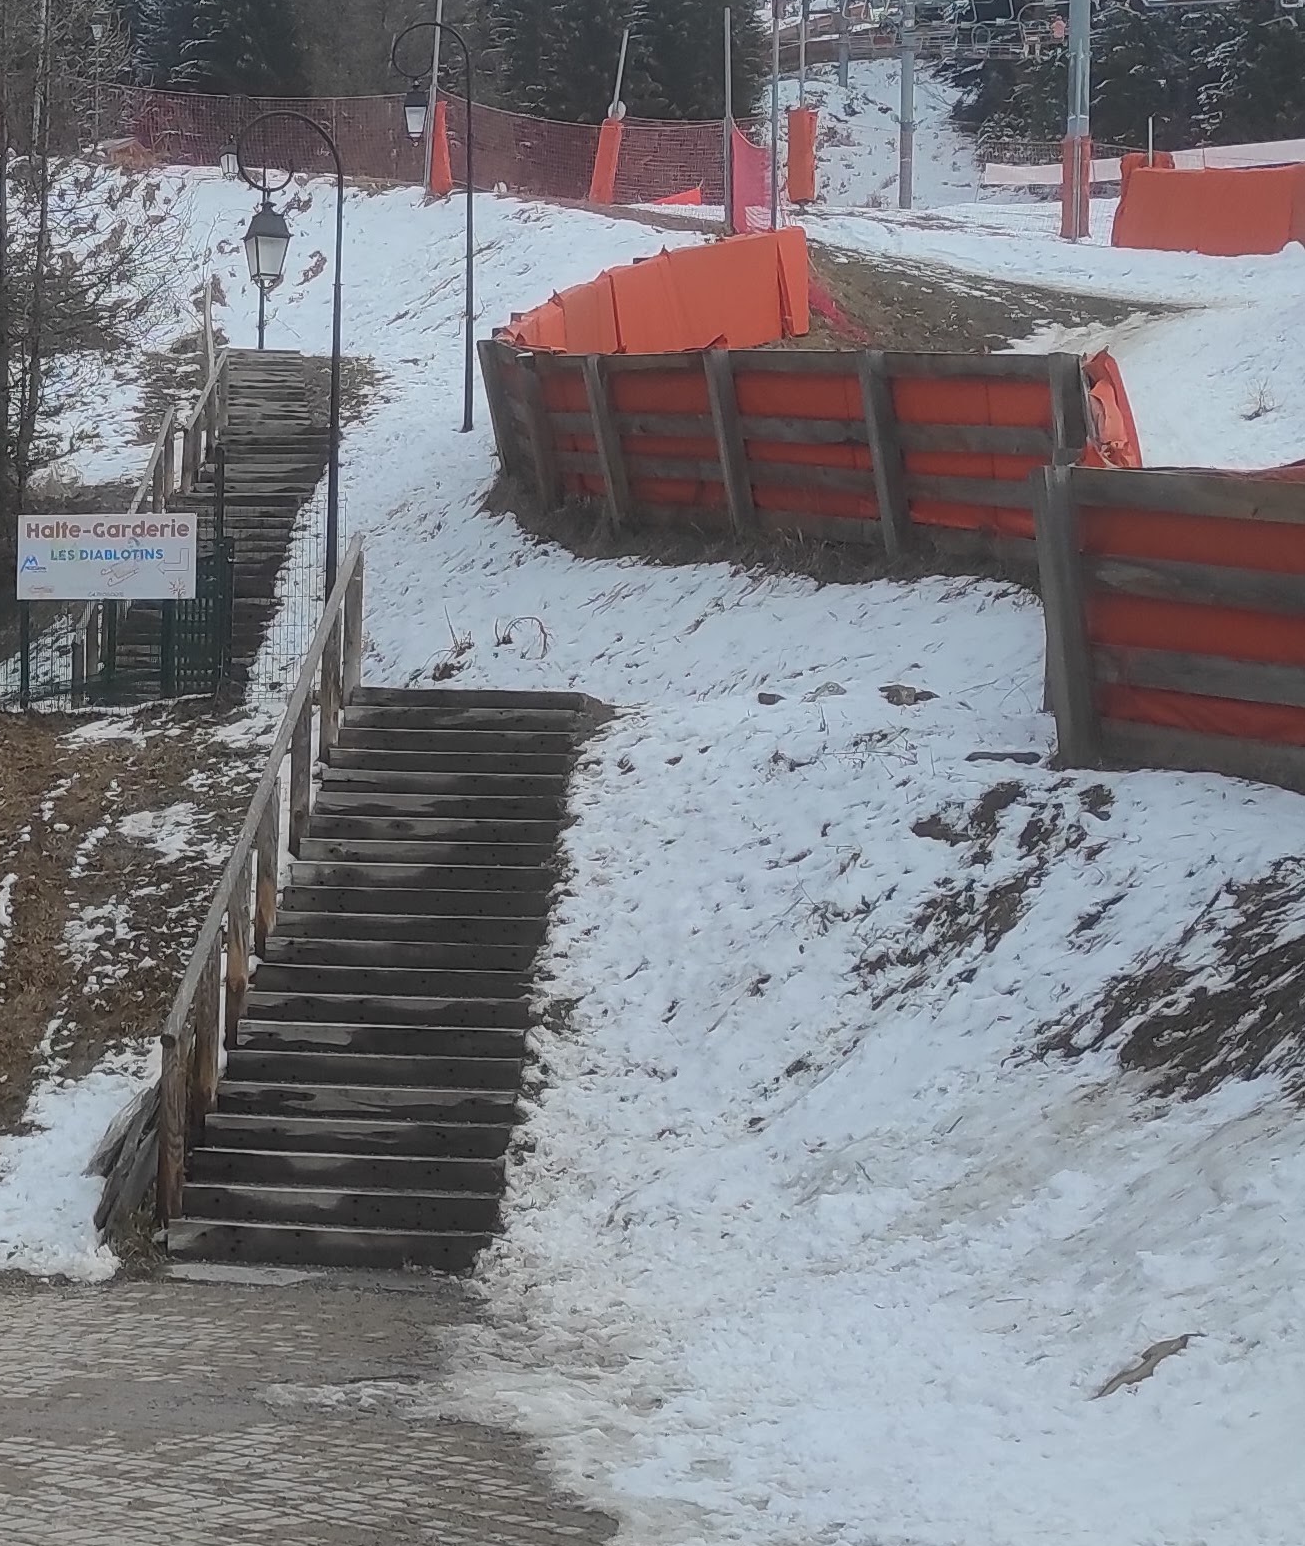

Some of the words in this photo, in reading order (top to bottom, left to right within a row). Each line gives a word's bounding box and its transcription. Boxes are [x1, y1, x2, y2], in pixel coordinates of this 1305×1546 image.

[26, 519, 190, 539] Halte-Garderie
[50, 548, 75, 561] LES
[79, 548, 164, 561] DIABLOTINS
